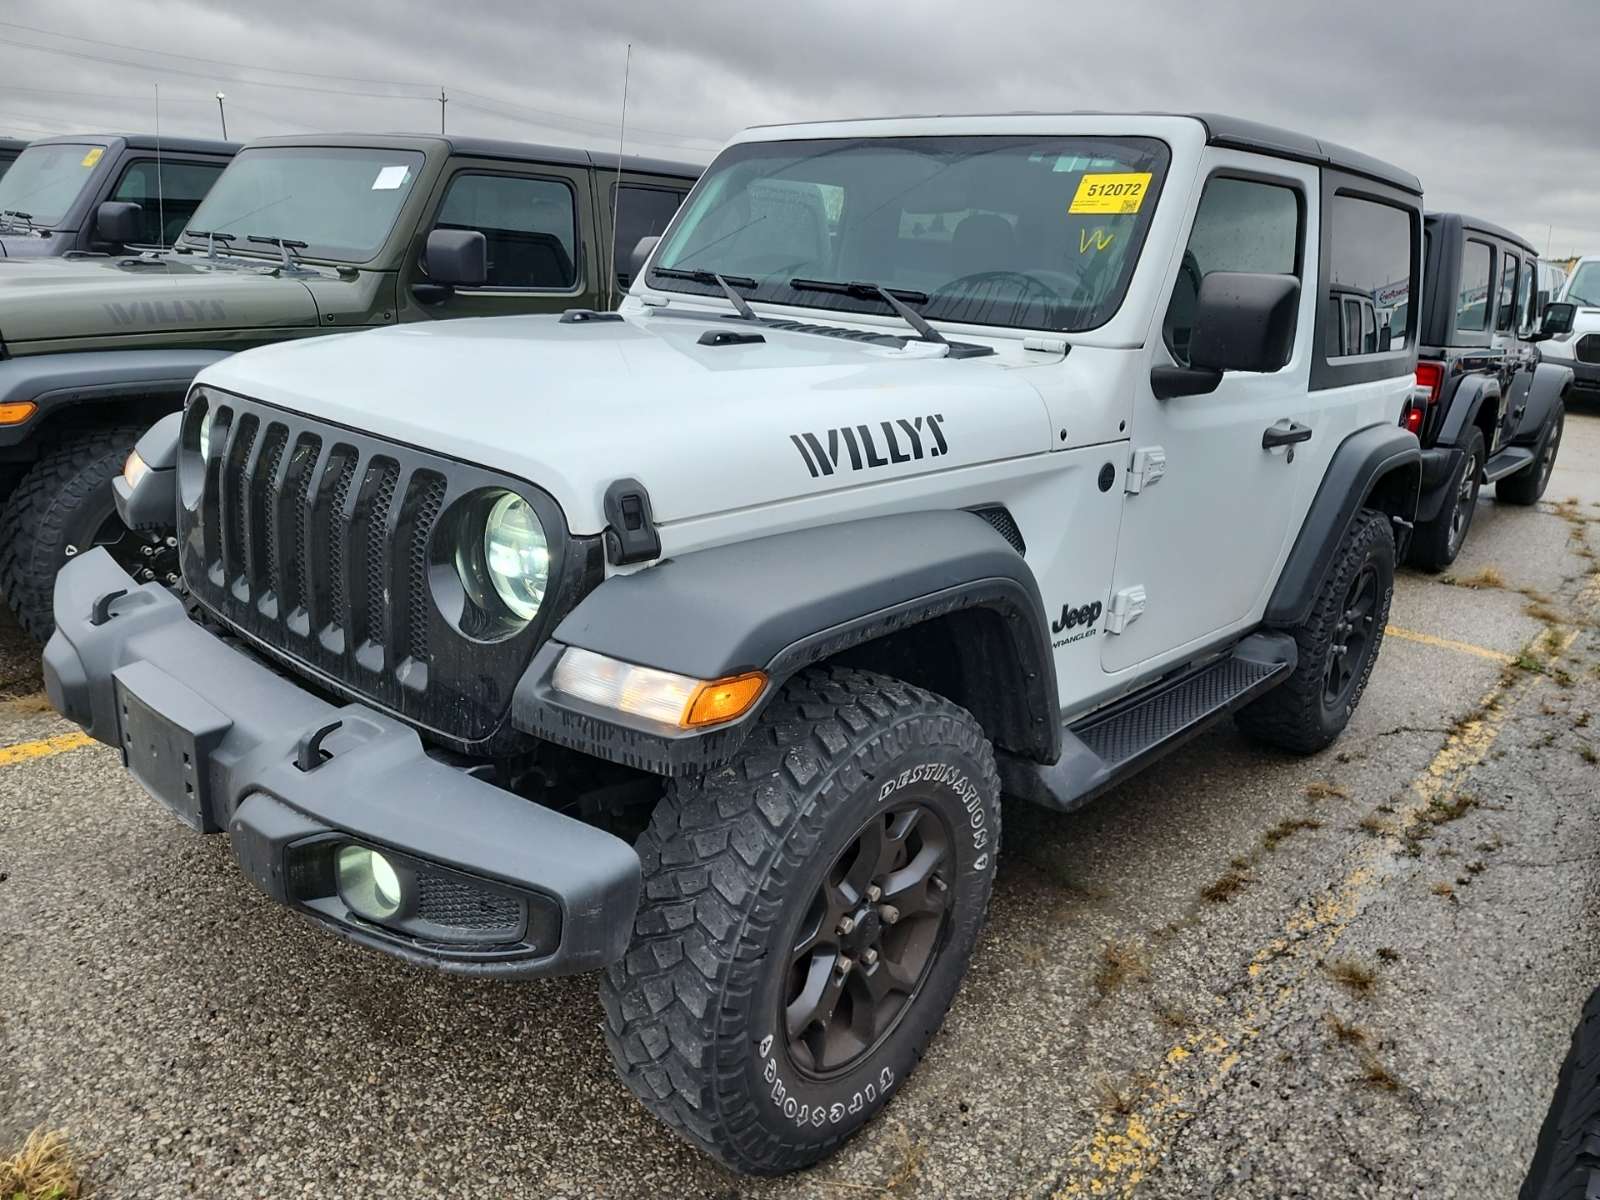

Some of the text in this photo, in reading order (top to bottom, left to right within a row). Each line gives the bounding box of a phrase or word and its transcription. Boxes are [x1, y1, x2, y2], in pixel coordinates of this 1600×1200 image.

[1087, 183, 1142, 196] 512072
[102, 299, 226, 325] WILLYS
[789, 414, 949, 478] WILLYS
[1052, 600, 1102, 633] Jeep
[1053, 629, 1096, 648] WRANGLER
[878, 763, 988, 849] DESTINATION
[764, 1057, 895, 1127] Firestone
